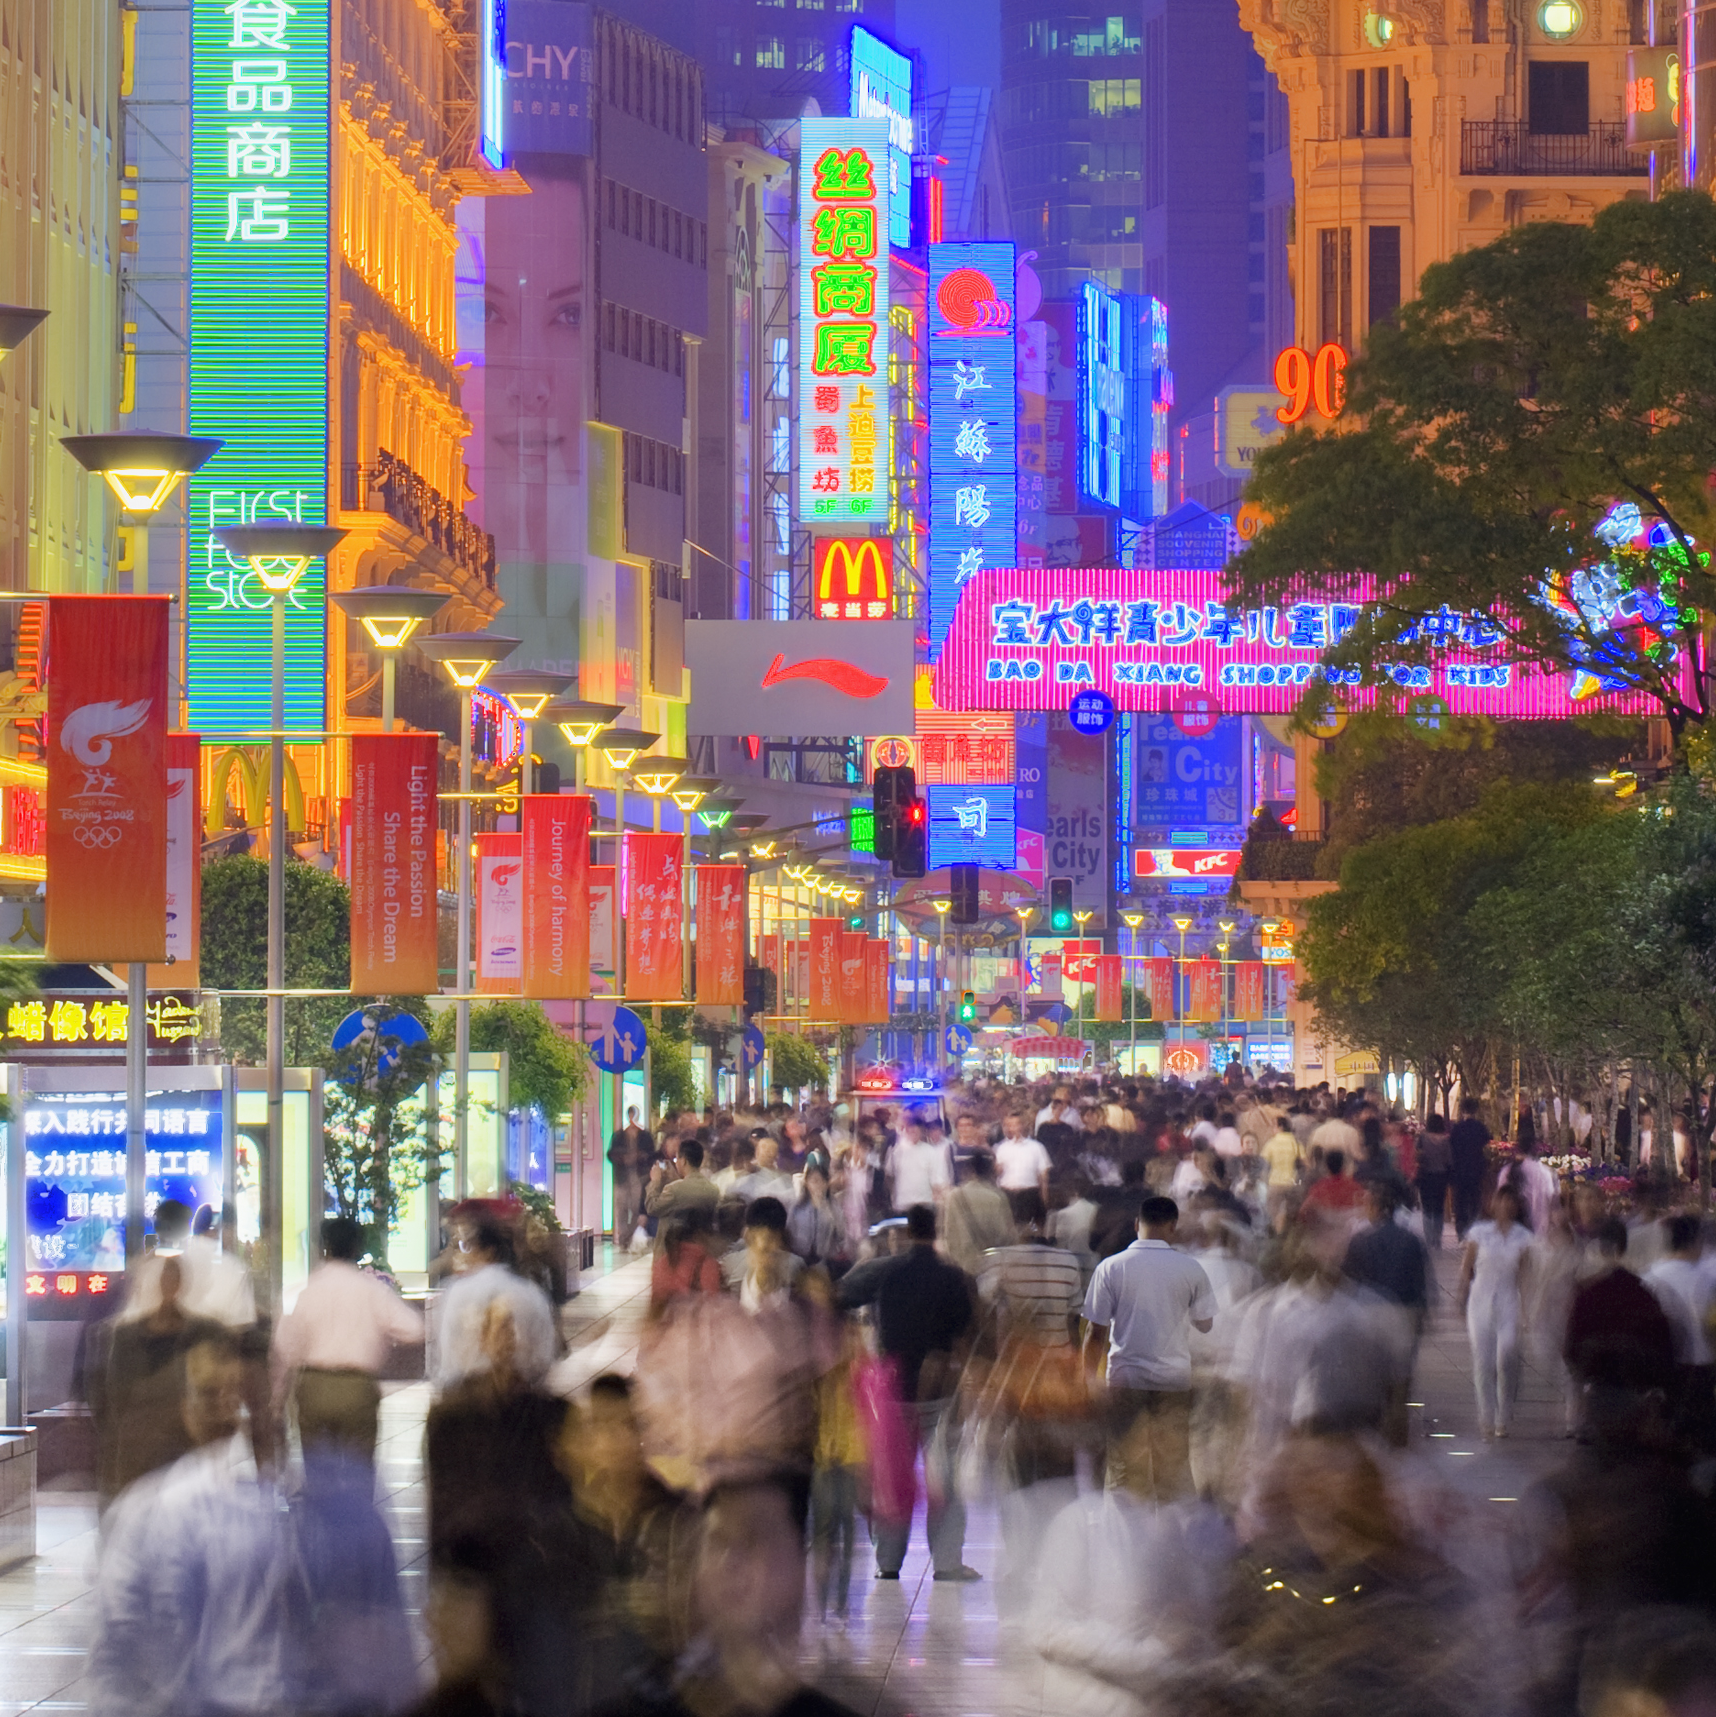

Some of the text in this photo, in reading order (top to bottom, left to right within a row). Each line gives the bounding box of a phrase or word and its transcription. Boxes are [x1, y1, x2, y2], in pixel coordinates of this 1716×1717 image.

[811, 147, 878, 377] 丝绸商厦
[820, 600, 887, 619] 麦当劳
[987, 658, 1043, 683] BAO
[1056, 661, 1095, 685] DA
[1113, 663, 1203, 687] XIANG
[1446, 663, 1512, 688] KIDS
[1175, 745, 1238, 785] City
[408, 765, 428, 918] Light the Passion
[1052, 840, 1101, 876] City
[1194, 852, 1229, 873] KFC
[383, 811, 401, 963] Share the Dream
[548, 817, 567, 977] Journey of harmony
[1068, 958, 1097, 975] KFC
[24, 1273, 109, 1296] 文明在
